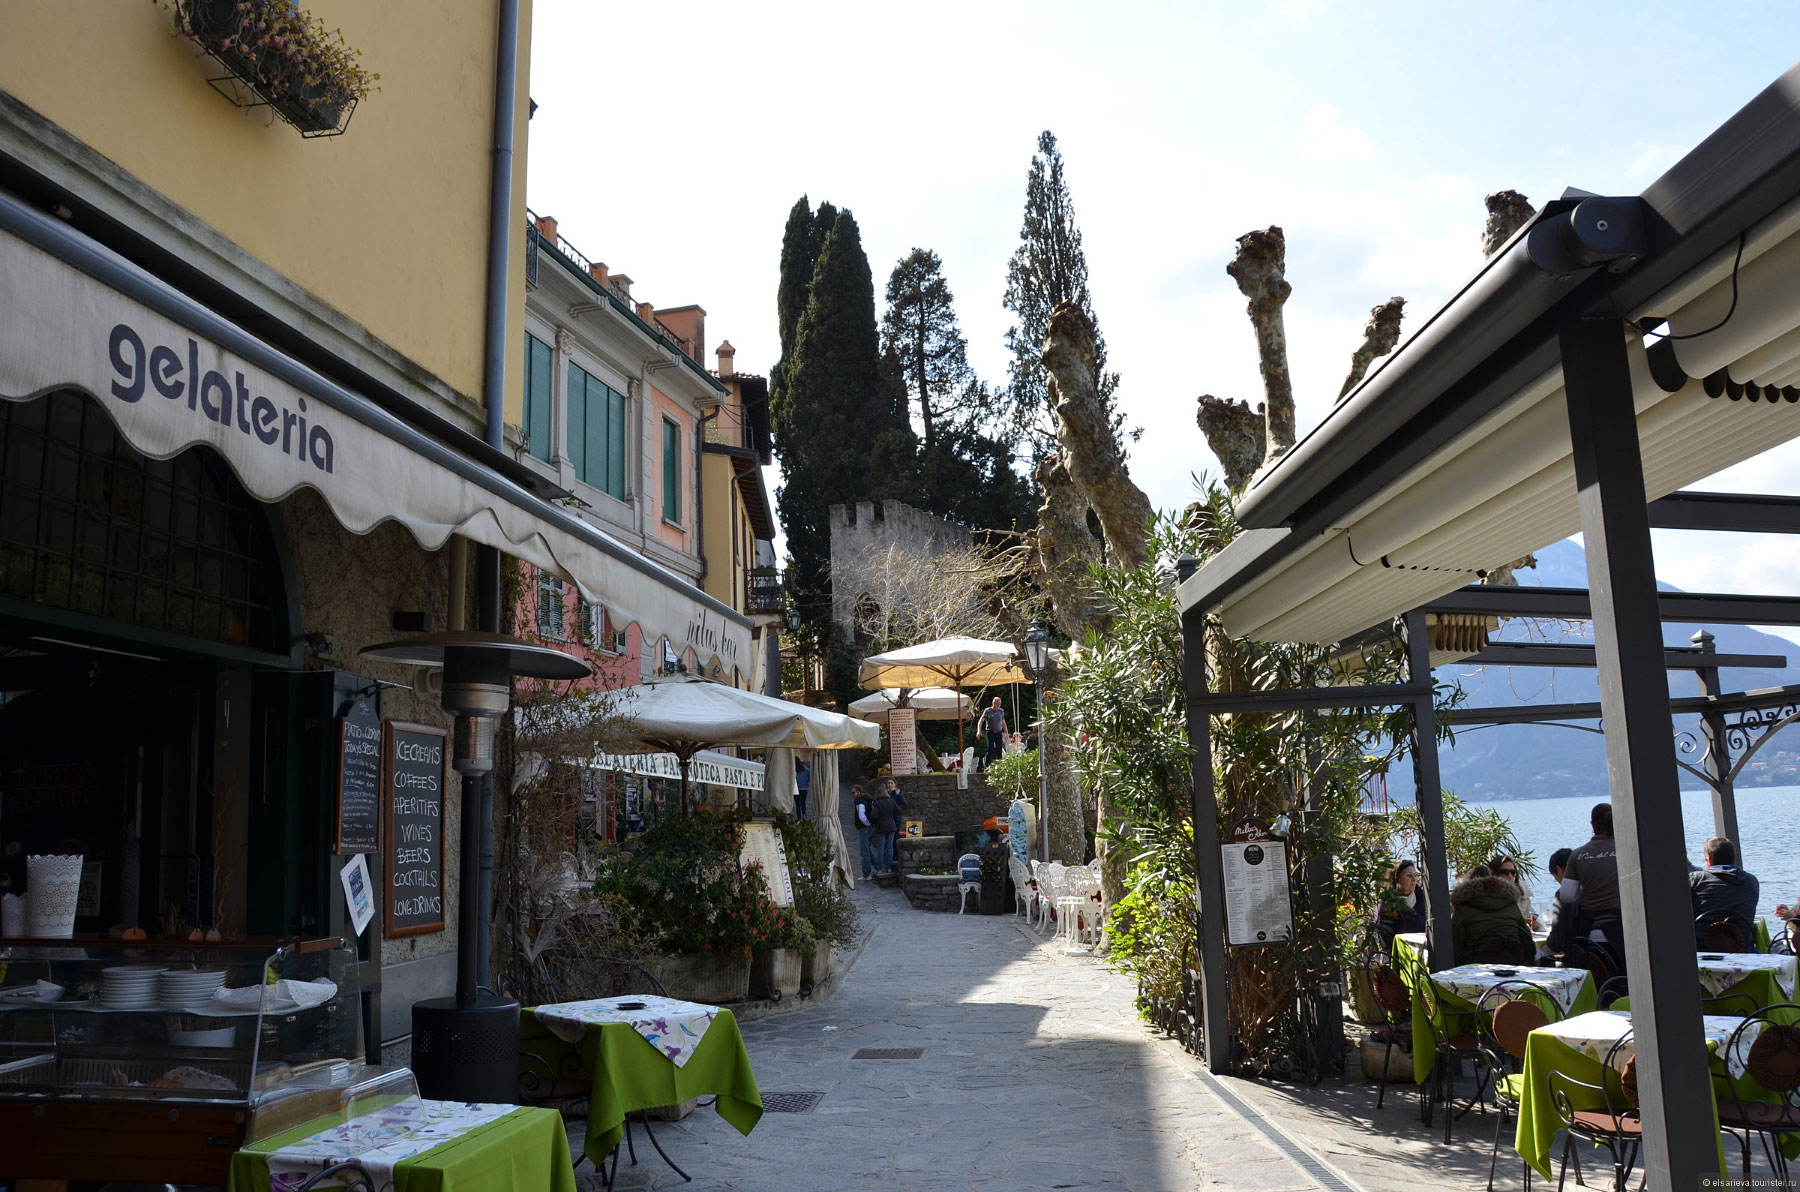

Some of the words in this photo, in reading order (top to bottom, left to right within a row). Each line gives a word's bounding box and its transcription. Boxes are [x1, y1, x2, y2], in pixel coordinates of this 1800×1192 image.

[108, 324, 334, 474] gelateria
[721, 619, 737, 661] bar
[593, 753, 657, 774] ELATERIA
[724, 767, 748, 786] PASTA
[750, 772, 755, 787] E
[394, 771, 438, 791] COFFEES
[393, 797, 439, 817] APERITIFS
[401, 823, 432, 843] WINES
[396, 847, 431, 864] BEERS
[393, 868, 438, 888] COCKTAILS
[394, 899, 413, 917] LONG
[412, 896, 441, 915] DRINKS
